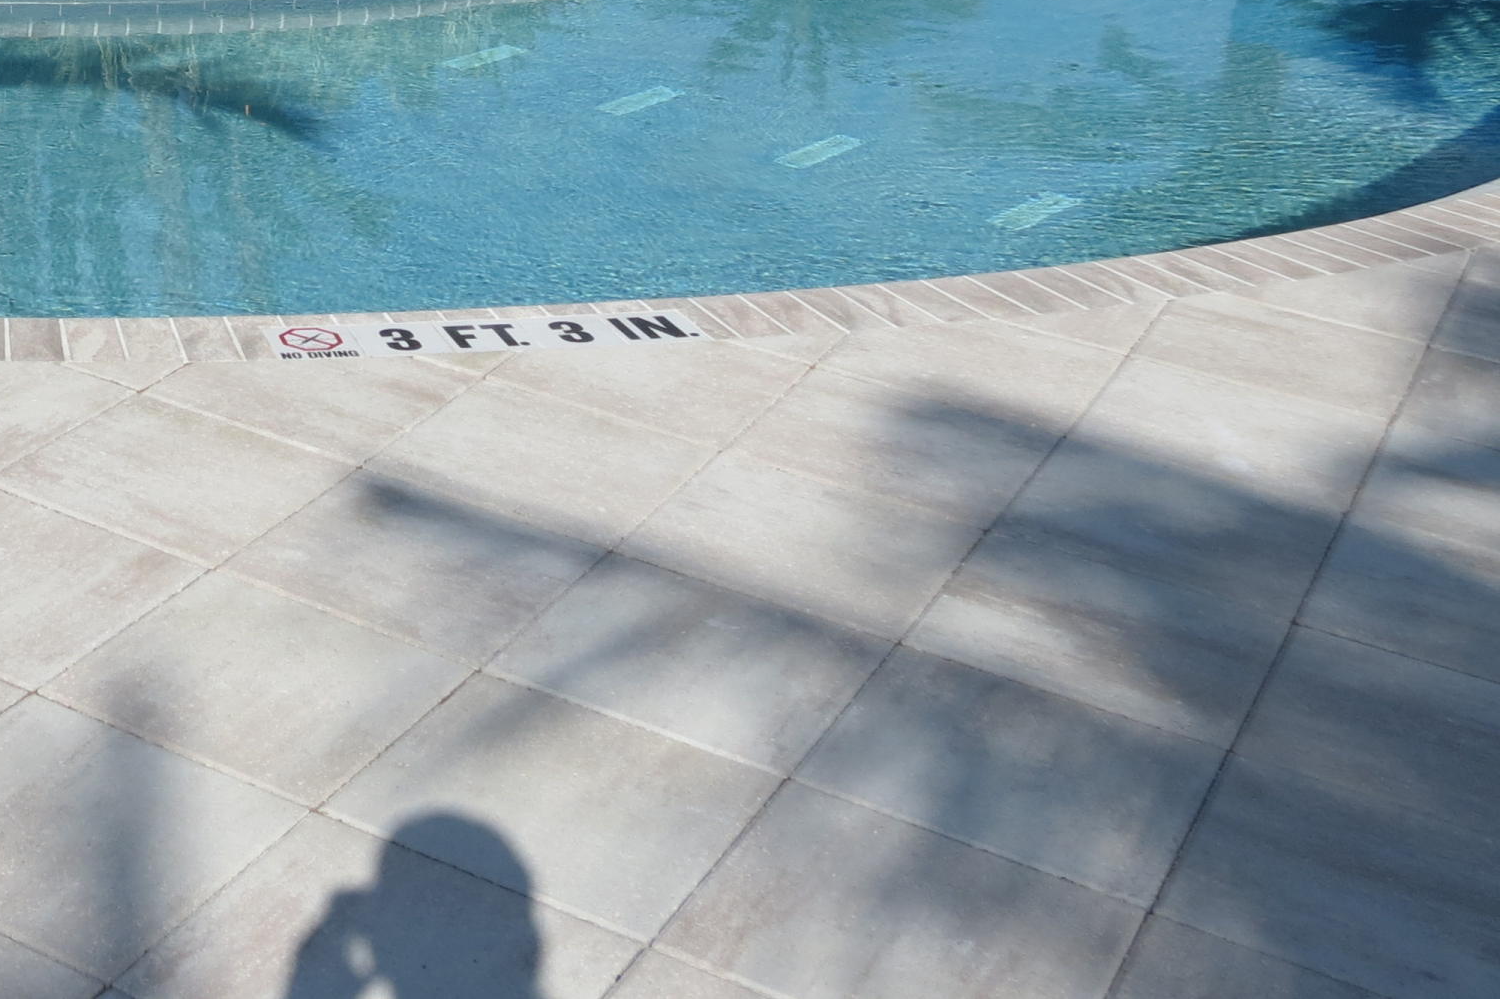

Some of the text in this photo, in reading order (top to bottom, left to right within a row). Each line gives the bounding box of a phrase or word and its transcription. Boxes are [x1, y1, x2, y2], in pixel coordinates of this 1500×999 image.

[378, 315, 700, 351] 3 FT. 3 IN.
[280, 350, 360, 360] NO DIVING
